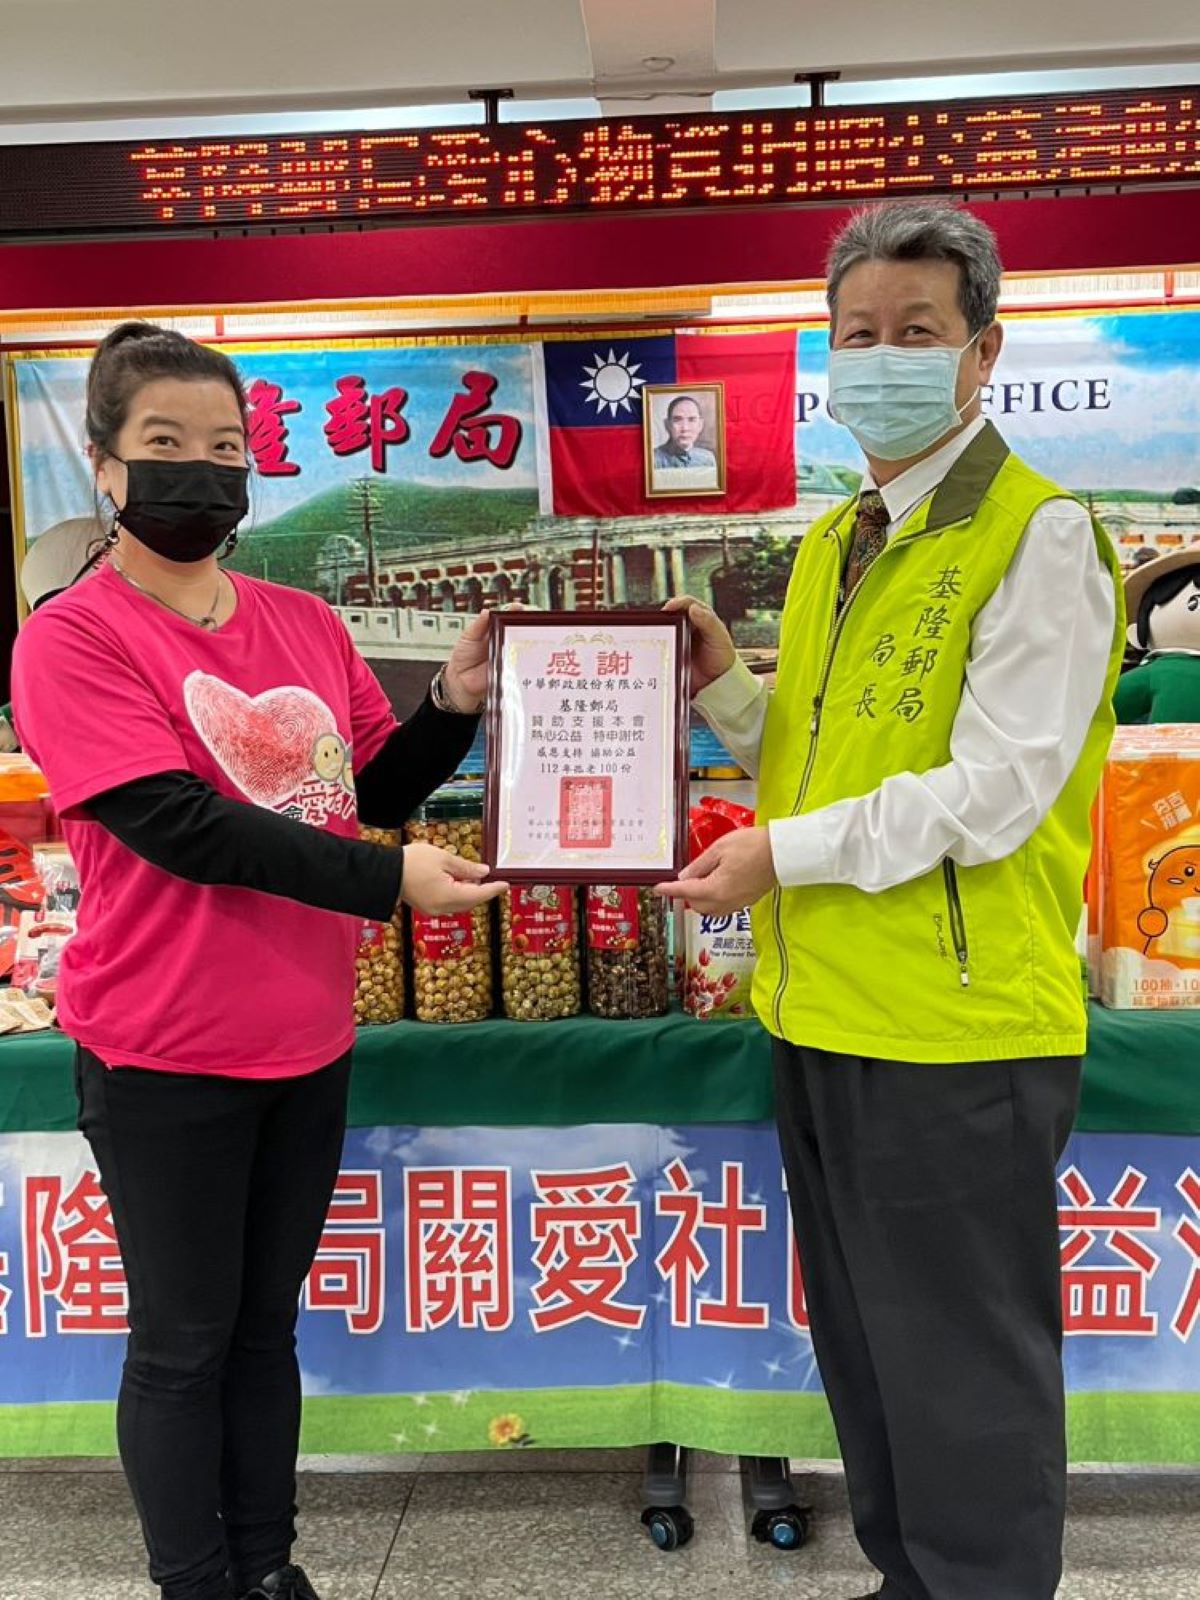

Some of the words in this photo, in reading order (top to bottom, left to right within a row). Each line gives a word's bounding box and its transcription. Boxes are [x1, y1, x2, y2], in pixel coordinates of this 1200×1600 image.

[979, 379, 1111, 414] FFICE
[891, 566, 962, 723] 基隆郵局
[547, 650, 633, 676] 感謝
[855, 633, 896, 718] 局長
[522, 678, 658, 691] 中華郵政股份有限公司
[560, 699, 618, 712] 基隆郵局
